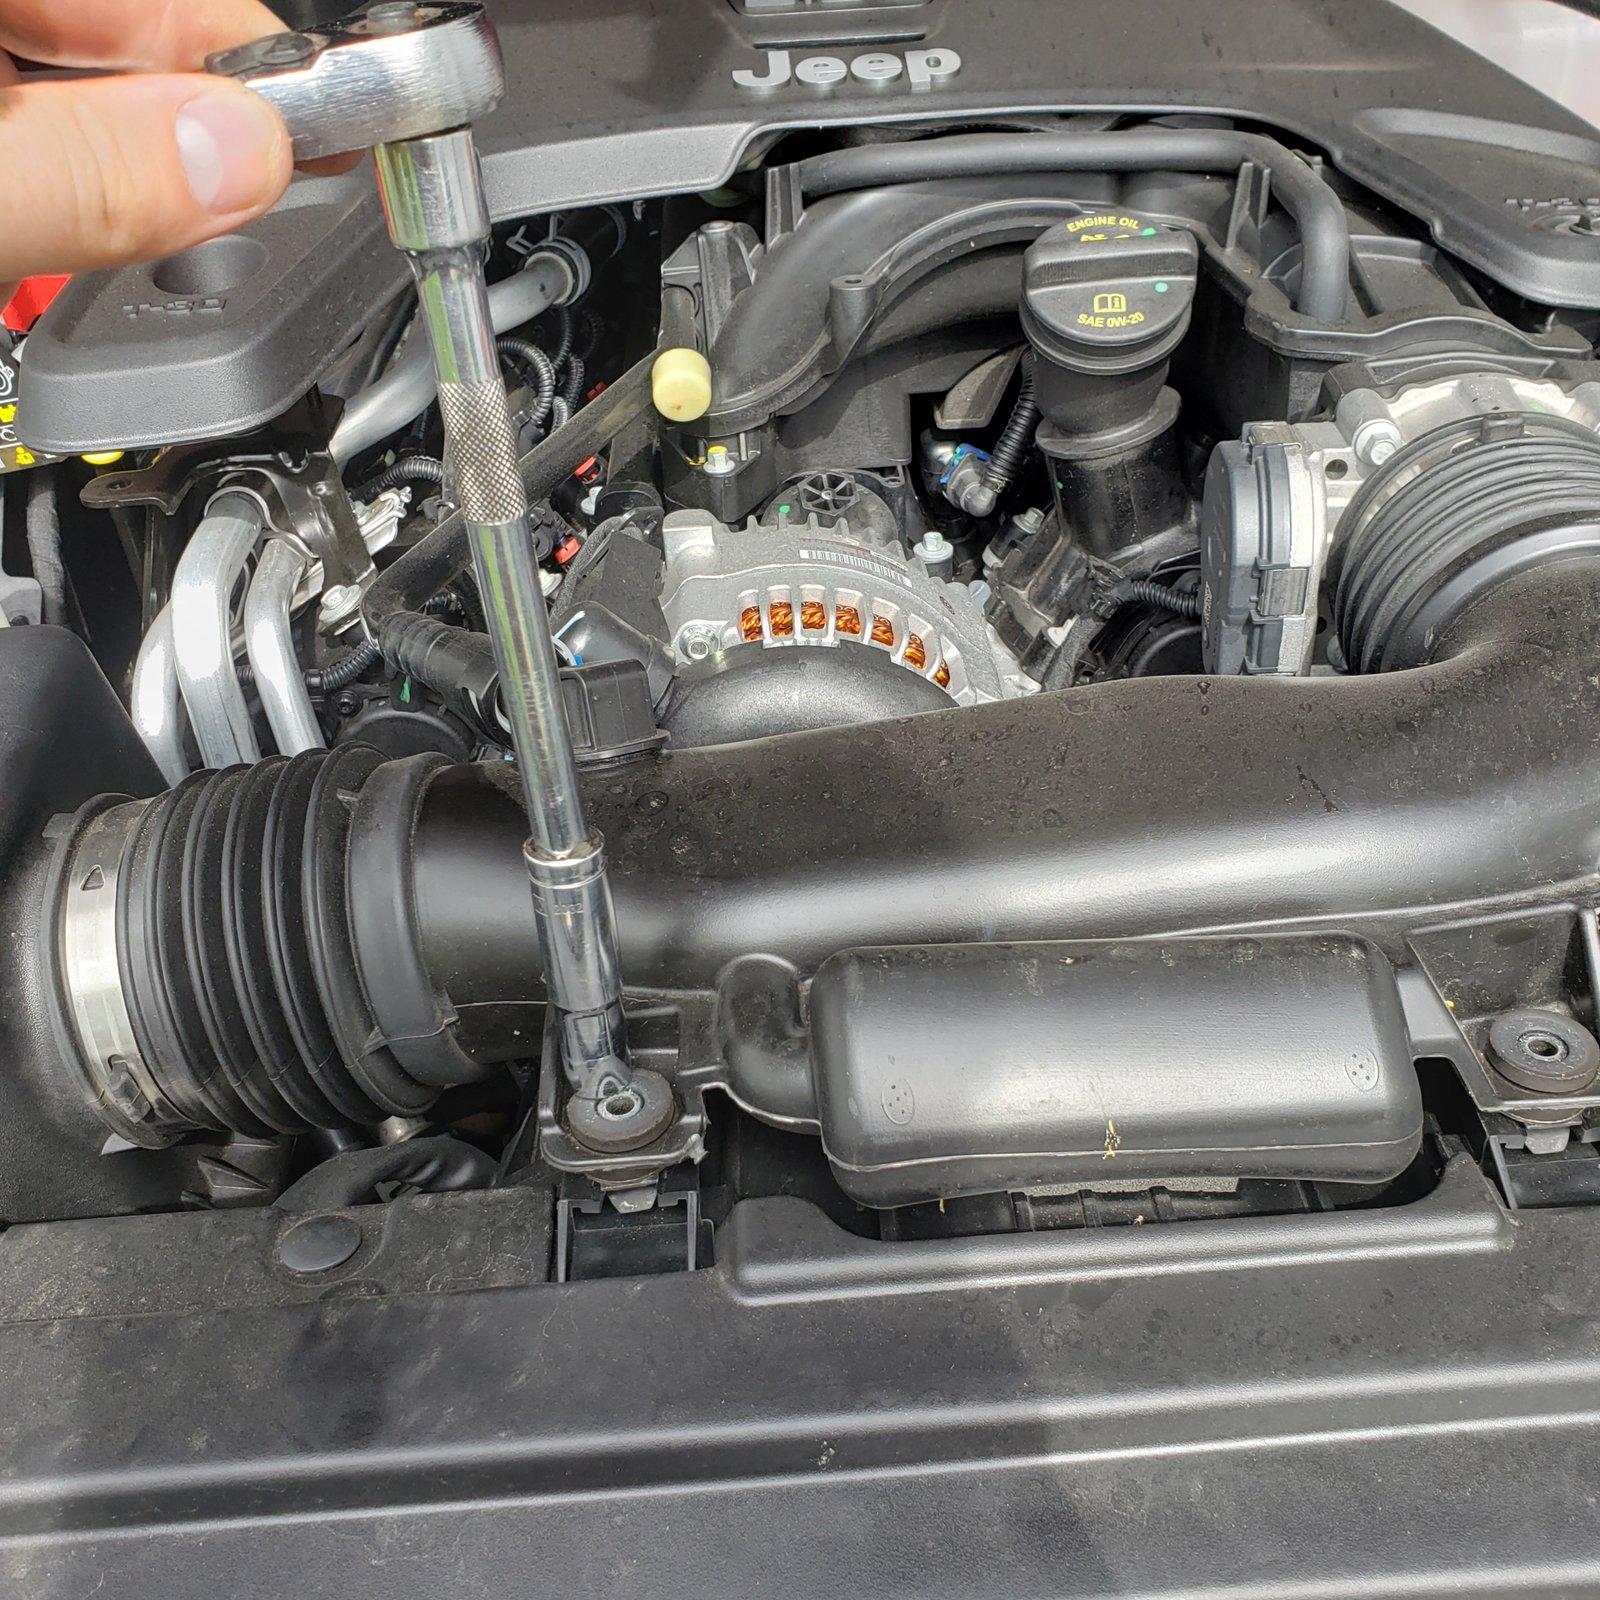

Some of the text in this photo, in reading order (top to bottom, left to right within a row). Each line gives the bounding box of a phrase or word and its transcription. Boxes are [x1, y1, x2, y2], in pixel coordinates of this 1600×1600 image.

[732, 48, 962, 94] Jeep
[1066, 216, 1140, 233] ENGINE OIL
[1076, 311, 1145, 328] SAE 0W-20
